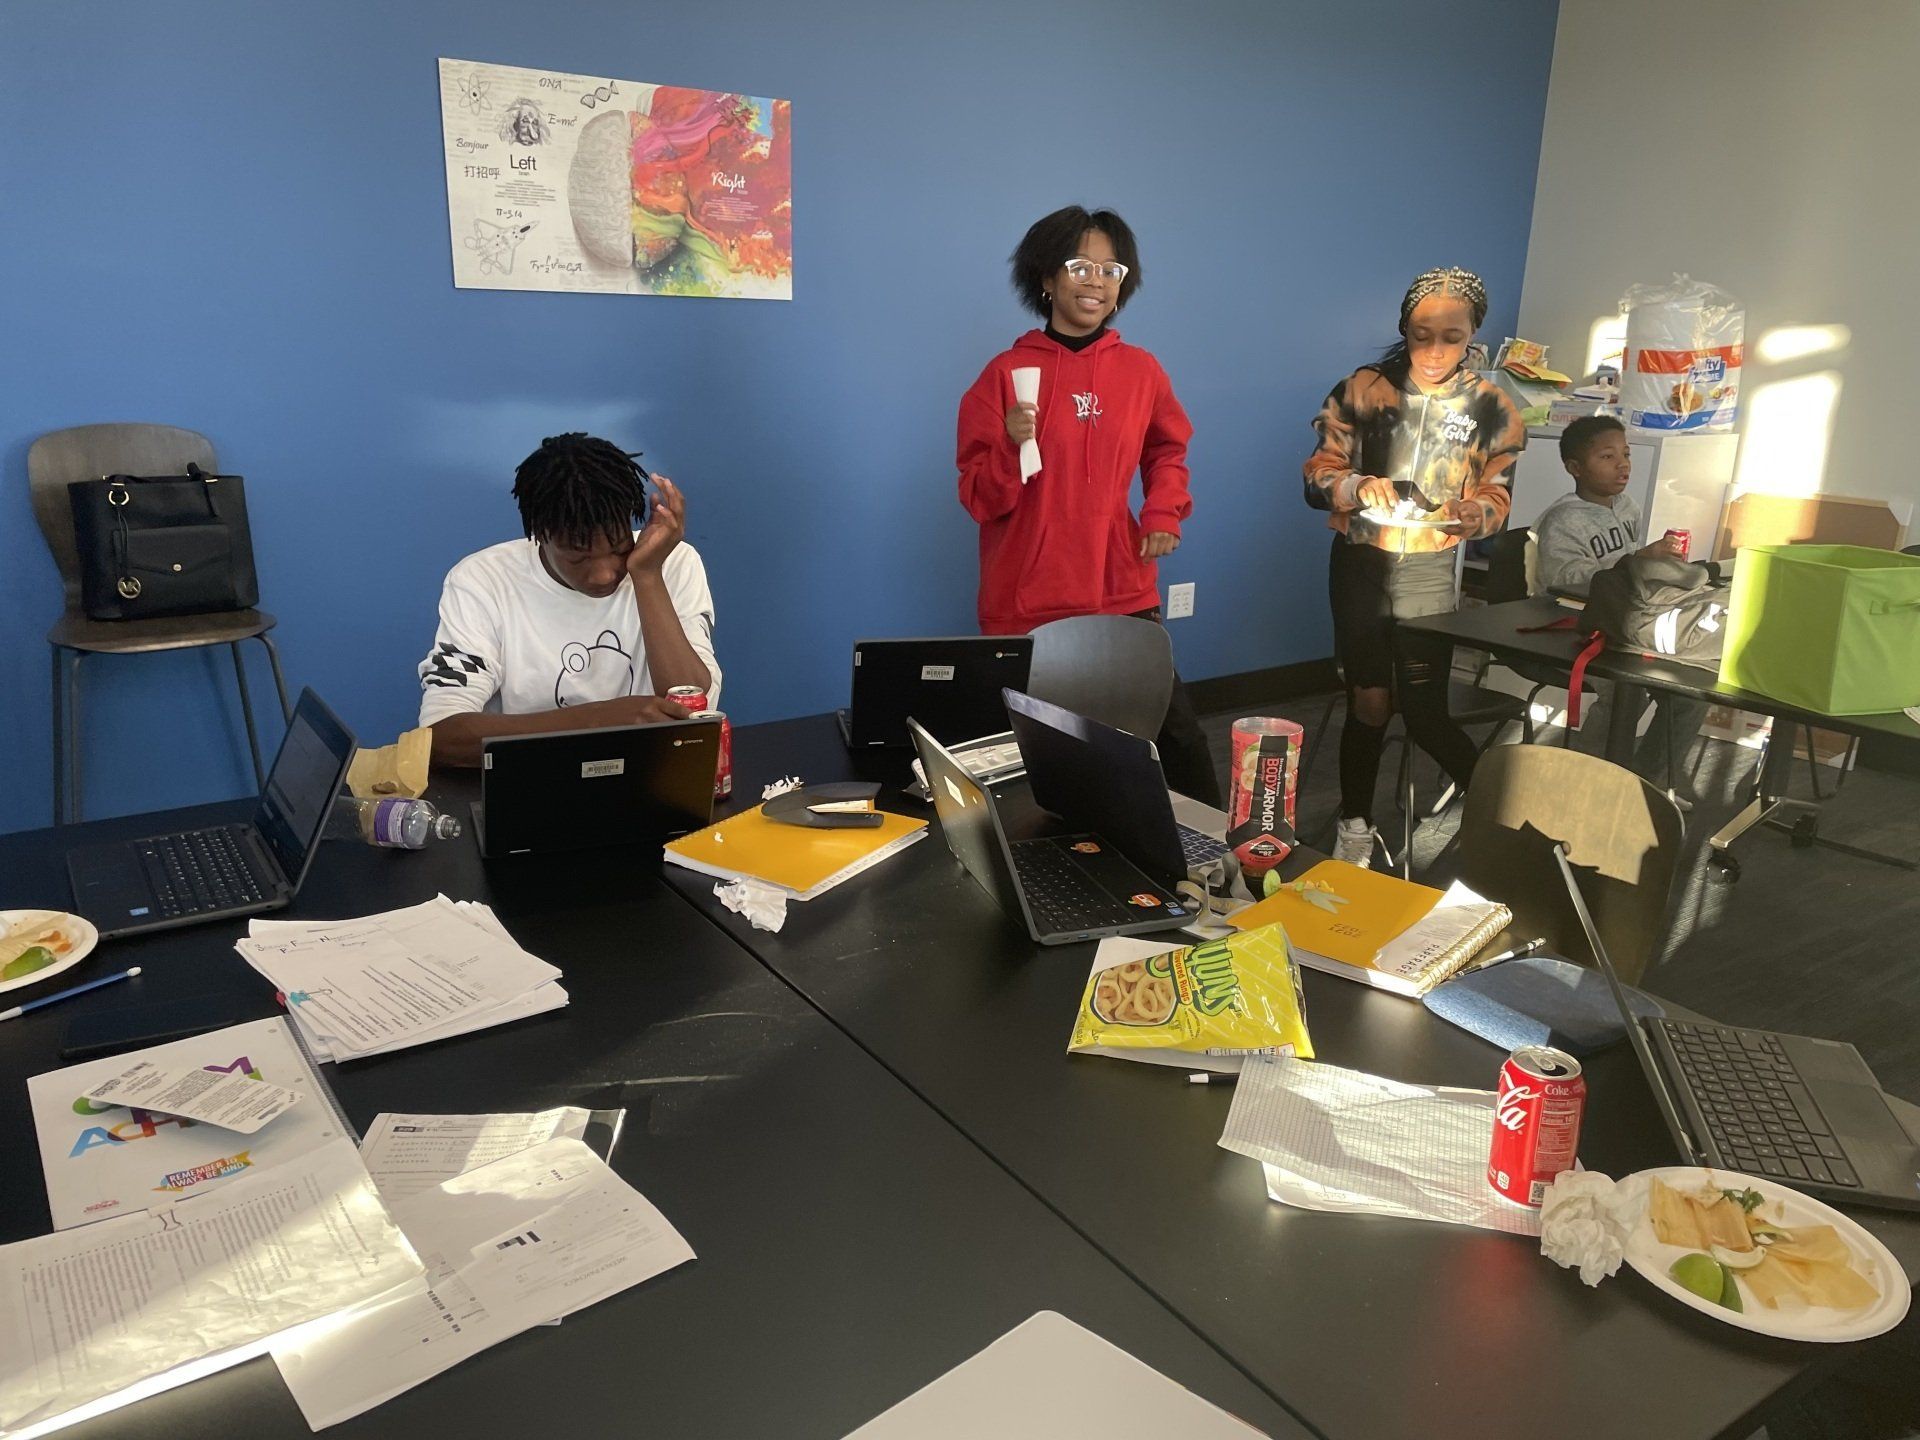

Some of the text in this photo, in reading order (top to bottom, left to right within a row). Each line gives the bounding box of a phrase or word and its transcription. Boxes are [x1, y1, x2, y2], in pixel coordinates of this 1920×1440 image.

[539, 77, 562, 90] DNA
[456, 137, 489, 153] Bonjour
[510, 154, 537, 171] Left
[711, 171, 746, 193] Right
[1444, 407, 1477, 431] Baby
[1443, 424, 1471, 442] Girl
[1590, 527, 1624, 559] OLD
[1261, 757, 1280, 832] BODYARMOR
[1396, 943, 1440, 974] PAPERAGE
[1179, 979, 1190, 1002] Rings
[1544, 1083, 1569, 1096] Coke
[166, 1162, 244, 1190] ALWAYS BE KIND
[169, 1157, 238, 1182] REMEMBER TO
